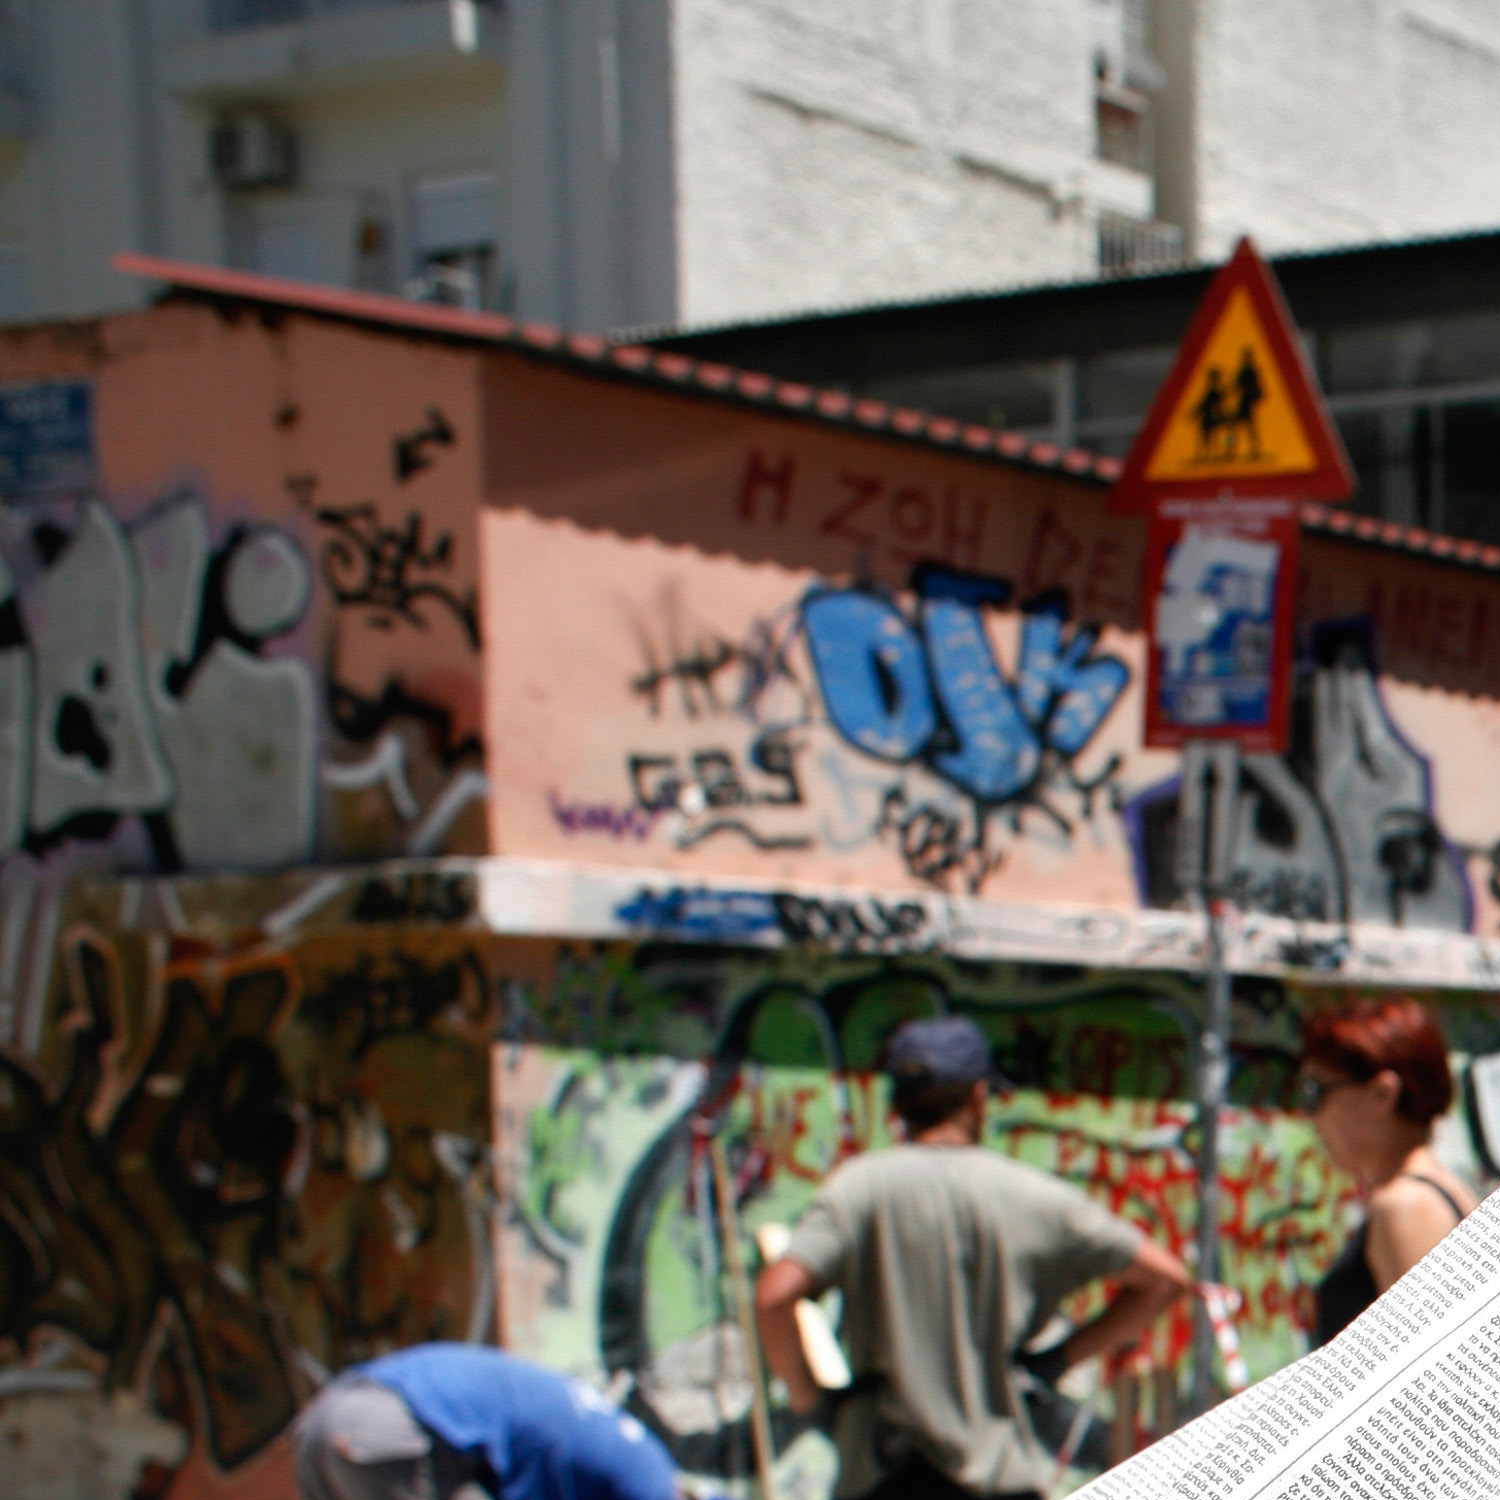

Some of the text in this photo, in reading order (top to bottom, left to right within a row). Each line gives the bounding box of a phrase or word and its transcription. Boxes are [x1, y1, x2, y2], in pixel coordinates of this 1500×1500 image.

[1477, 1340, 1491, 1355] να
[1388, 1396, 1450, 1452] κολουθούν τα
[1398, 1386, 1451, 1432] πολίτες που
[1435, 1396, 1455, 1417] ίδια
[1450, 1412, 1487, 1447] στελέχη
[1448, 1391, 1486, 1425] πολιτική
[1320, 1451, 1353, 1482] ζονταν
[1342, 1433, 1377, 1465] πέραση
[1354, 1424, 1383, 1451] στους
[1379, 1447, 1418, 1484] οποίους
[1396, 1440, 1420, 1465] τους
[1417, 1461, 1440, 1485] άνω
[1438, 1481, 1460, 1500] των
[1401, 1427, 1427, 1452] είναι
[1424, 1448, 1444, 1469] στη
[1440, 1465, 1478, 1498] μεγάλη
[1286, 1480, 1301, 1497] ζε
